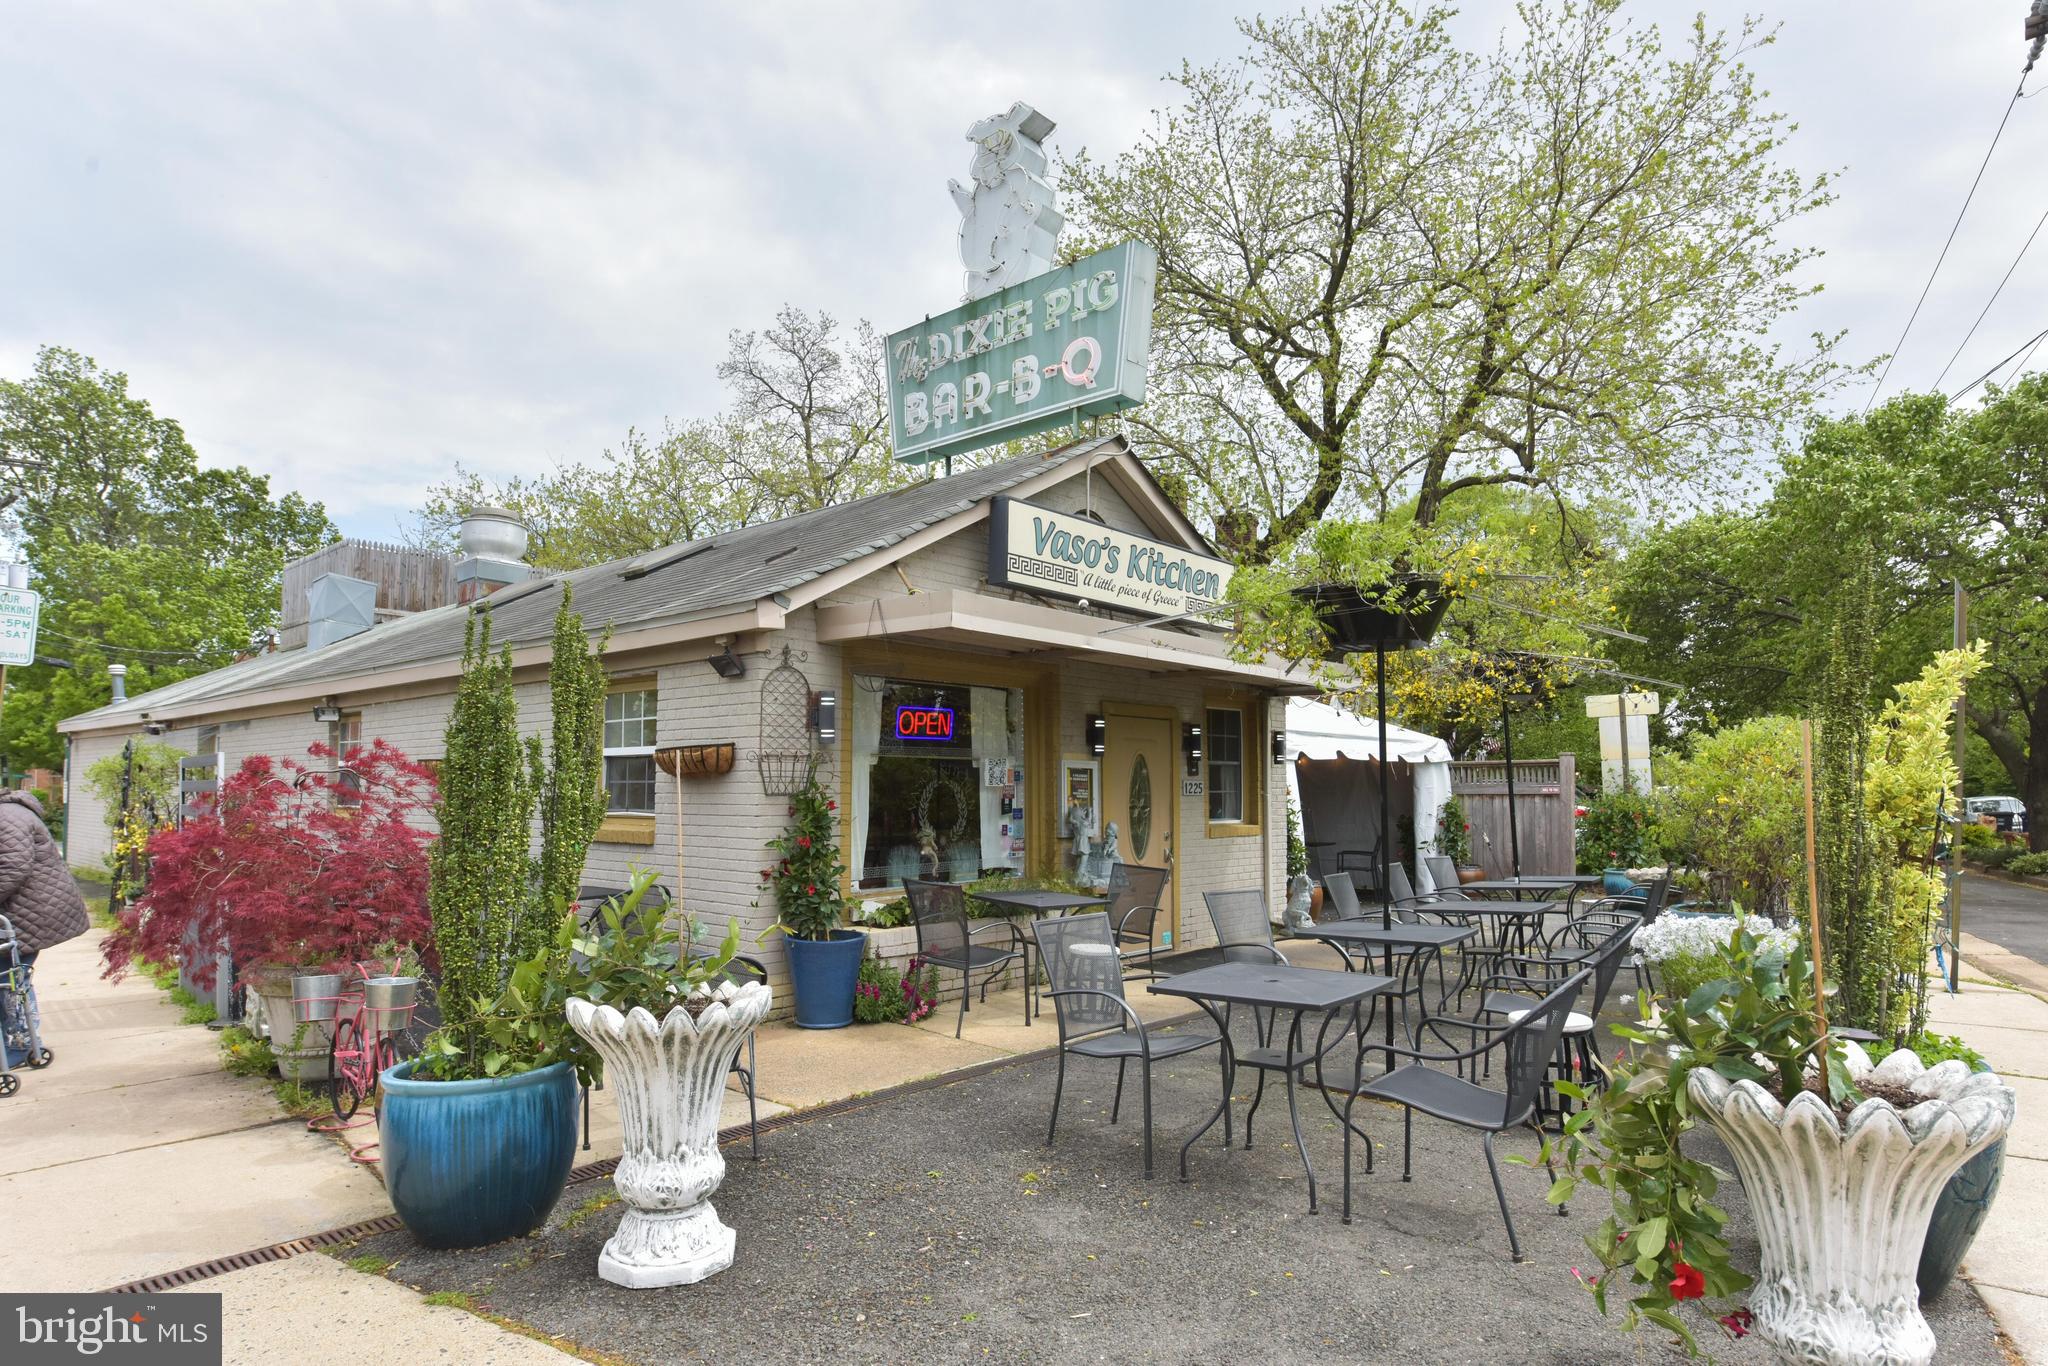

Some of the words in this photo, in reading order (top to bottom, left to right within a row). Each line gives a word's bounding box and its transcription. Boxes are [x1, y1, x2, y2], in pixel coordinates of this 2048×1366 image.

[927, 300, 1033, 371] DIXIE
[1043, 270, 1119, 331] PIG
[904, 336, 1102, 436] BAR-B-Q
[1033, 516, 1121, 574] Vaso's
[1126, 544, 1220, 600] Kitchen
[1094, 575, 1117, 592] little
[1116, 583, 1141, 598] piece
[1141, 588, 1154, 605] of
[899, 711, 951, 735] OPEN
[1184, 782, 1203, 794] 1225
